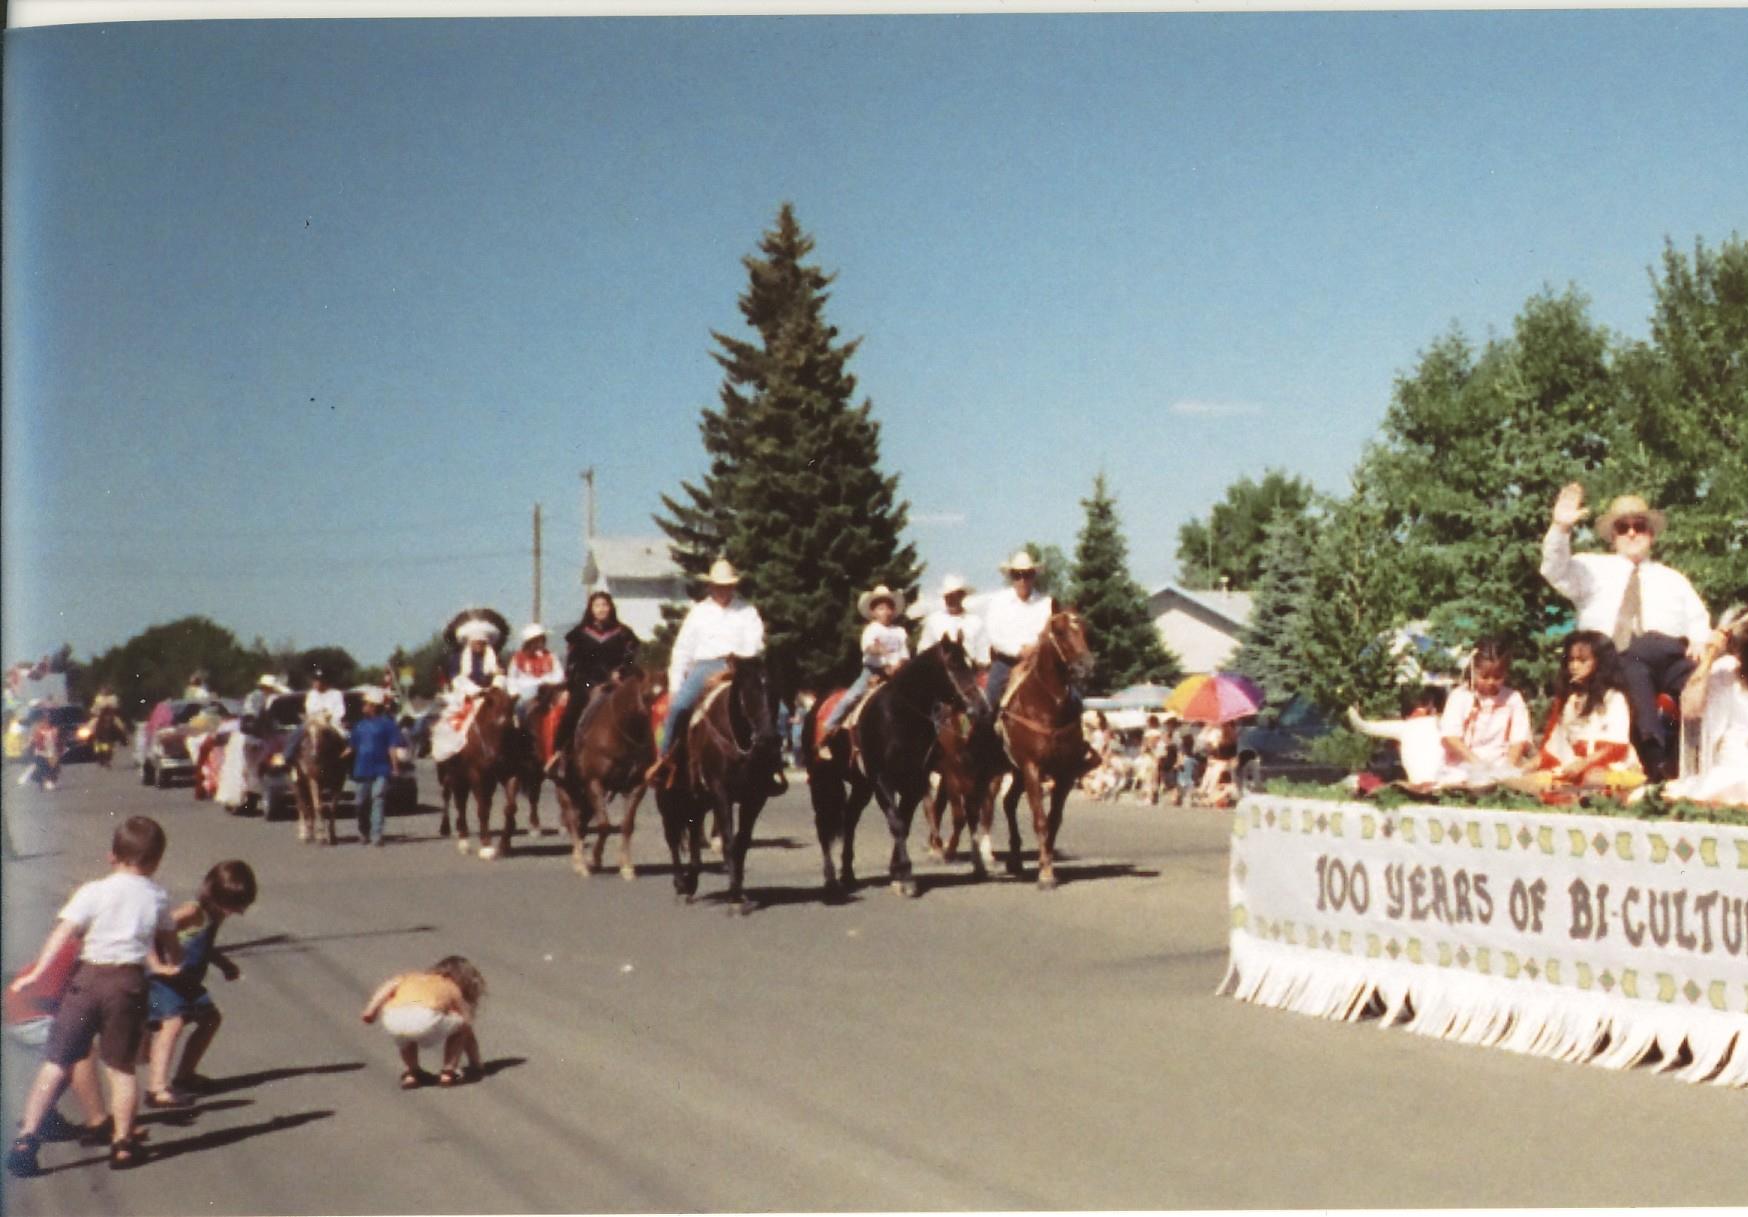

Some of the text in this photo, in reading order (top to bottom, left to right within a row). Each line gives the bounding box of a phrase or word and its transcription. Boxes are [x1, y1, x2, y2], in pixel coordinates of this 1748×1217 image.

[1315, 854, 1370, 915] 100
[1384, 861, 1494, 926] YEARS
[1508, 876, 1548, 933] OF
